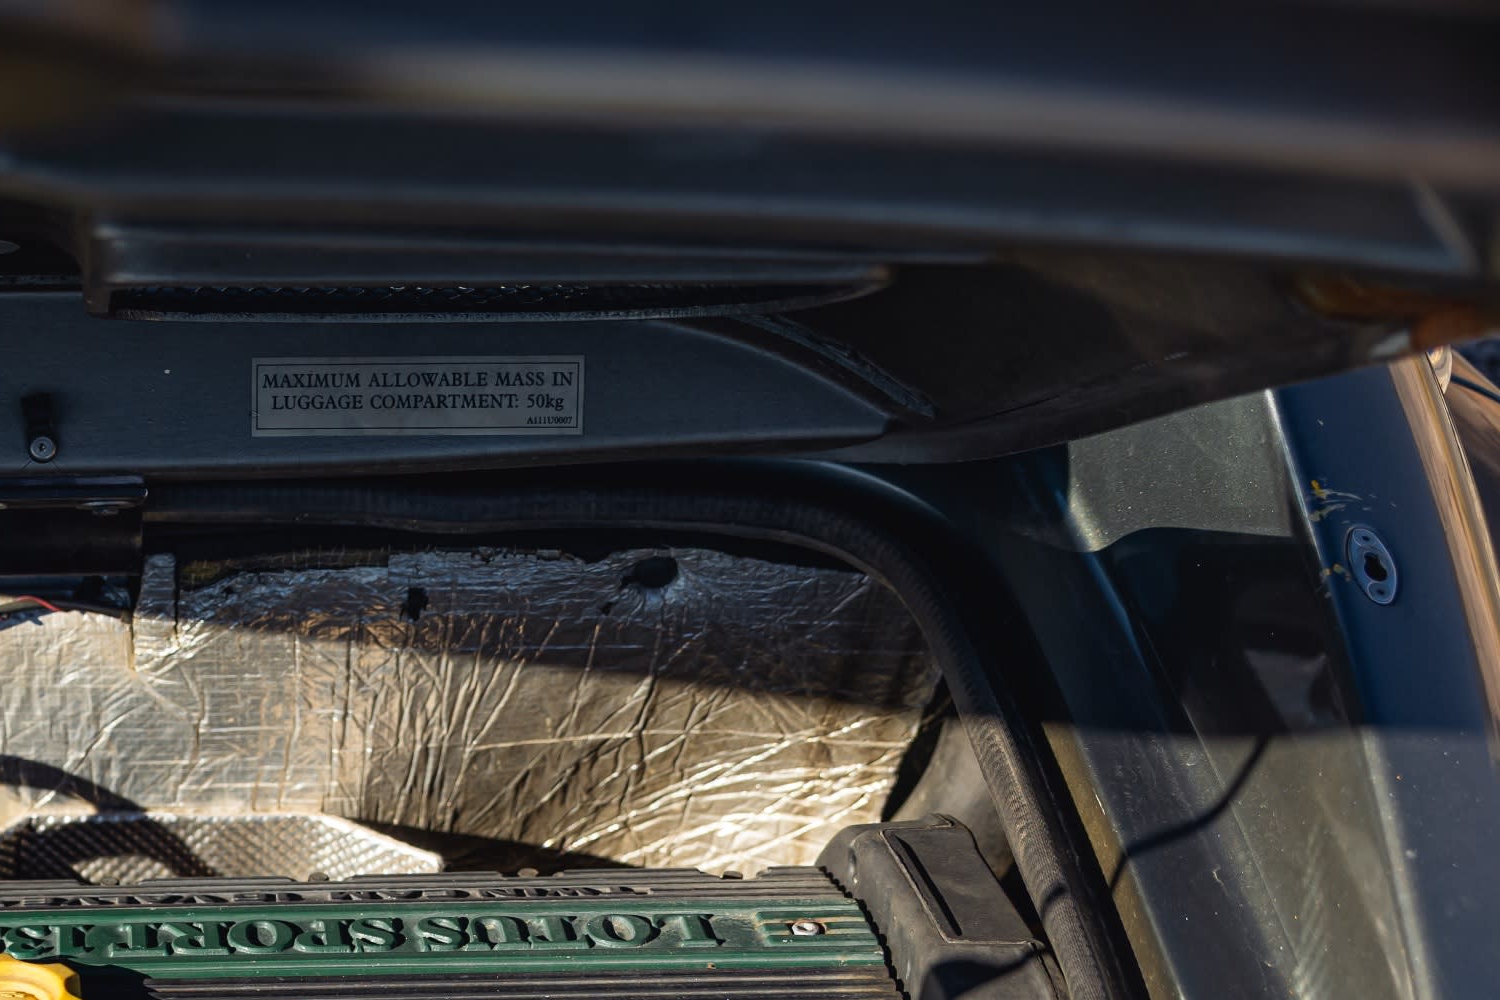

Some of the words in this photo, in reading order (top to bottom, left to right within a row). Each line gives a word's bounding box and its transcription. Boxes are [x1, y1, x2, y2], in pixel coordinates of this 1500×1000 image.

[262, 373, 361, 389] MAXIMUM
[368, 371, 488, 388] ALLOWABLE
[495, 371, 545, 387] MASS
[552, 371, 574, 386] IN
[271, 395, 363, 410] LUGGAGE
[370, 393, 519, 409] COMPARTMENT:
[526, 393, 565, 412] 50kg
[108, 915, 406, 958] SPORT
[416, 913, 725, 952] LOTUS
